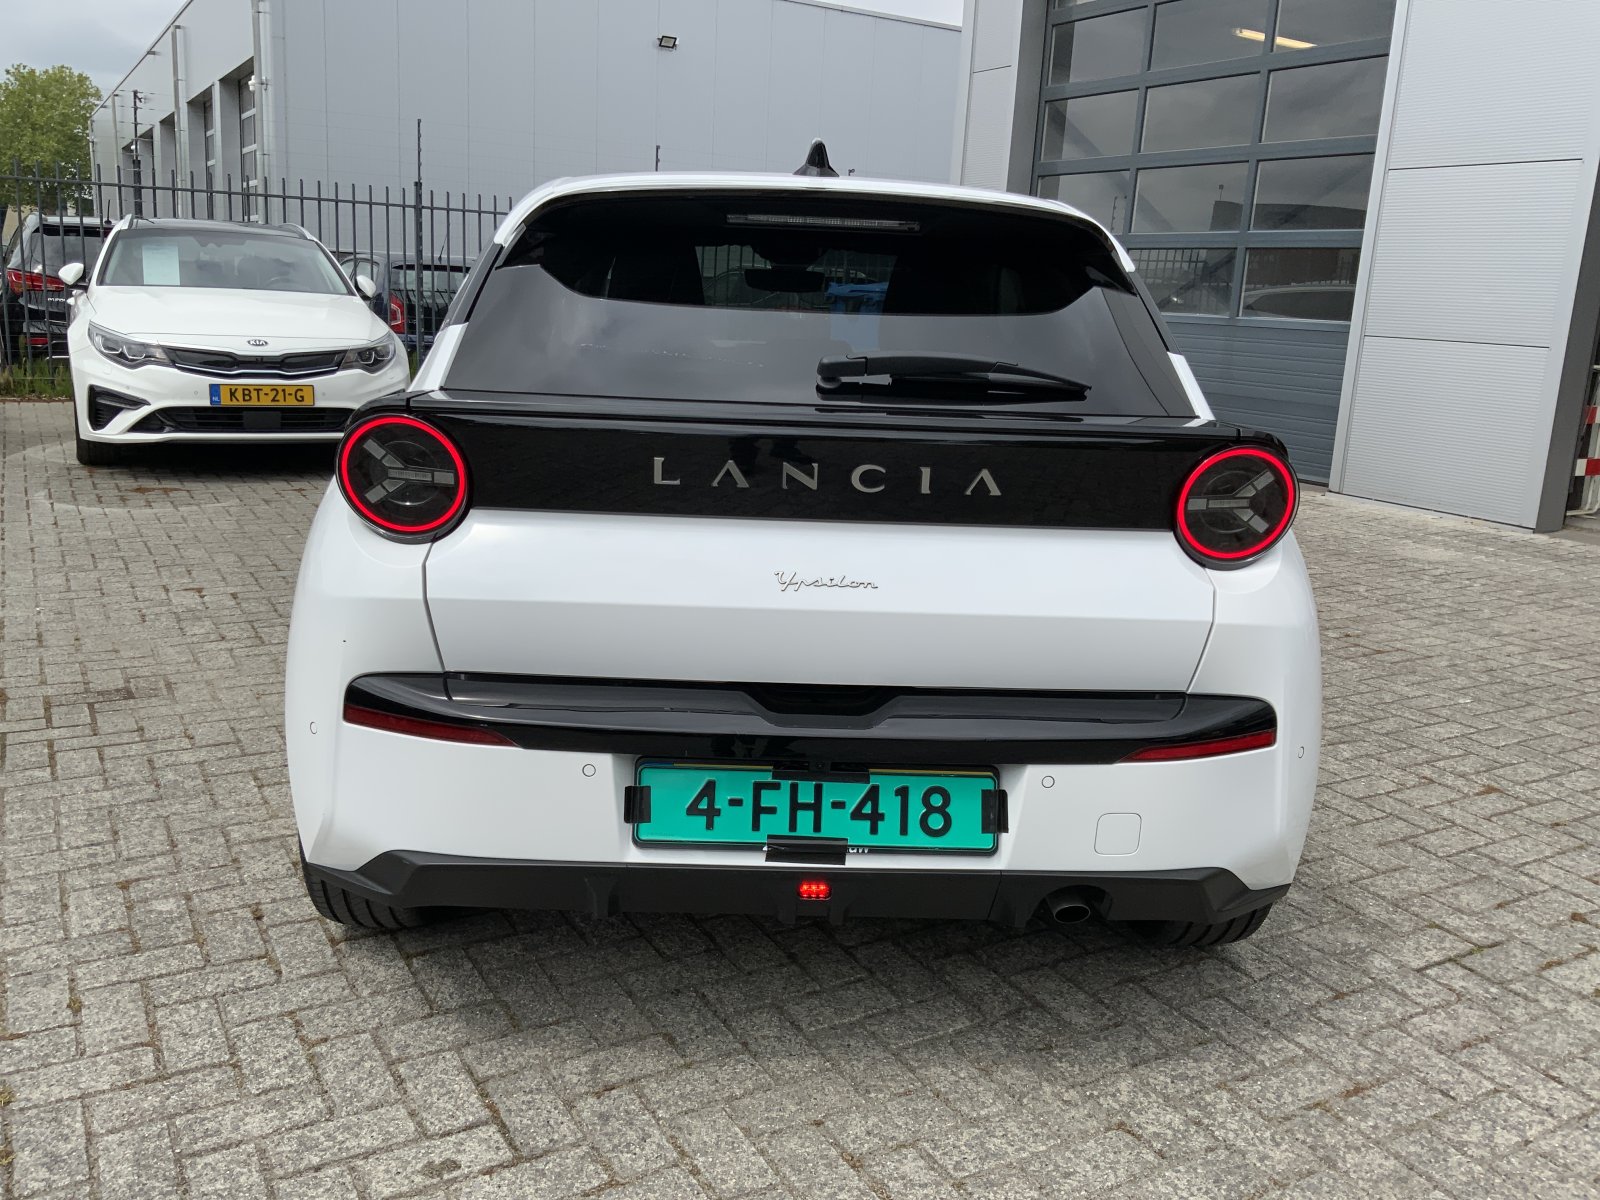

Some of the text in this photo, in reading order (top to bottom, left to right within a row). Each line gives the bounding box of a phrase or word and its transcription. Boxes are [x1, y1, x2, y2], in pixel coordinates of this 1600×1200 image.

[229, 388, 305, 403] KBT-21-G
[653, 457, 1002, 496] LANCIA
[774, 570, 879, 592] Ypsilon
[685, 778, 953, 838] 4-FH-418
